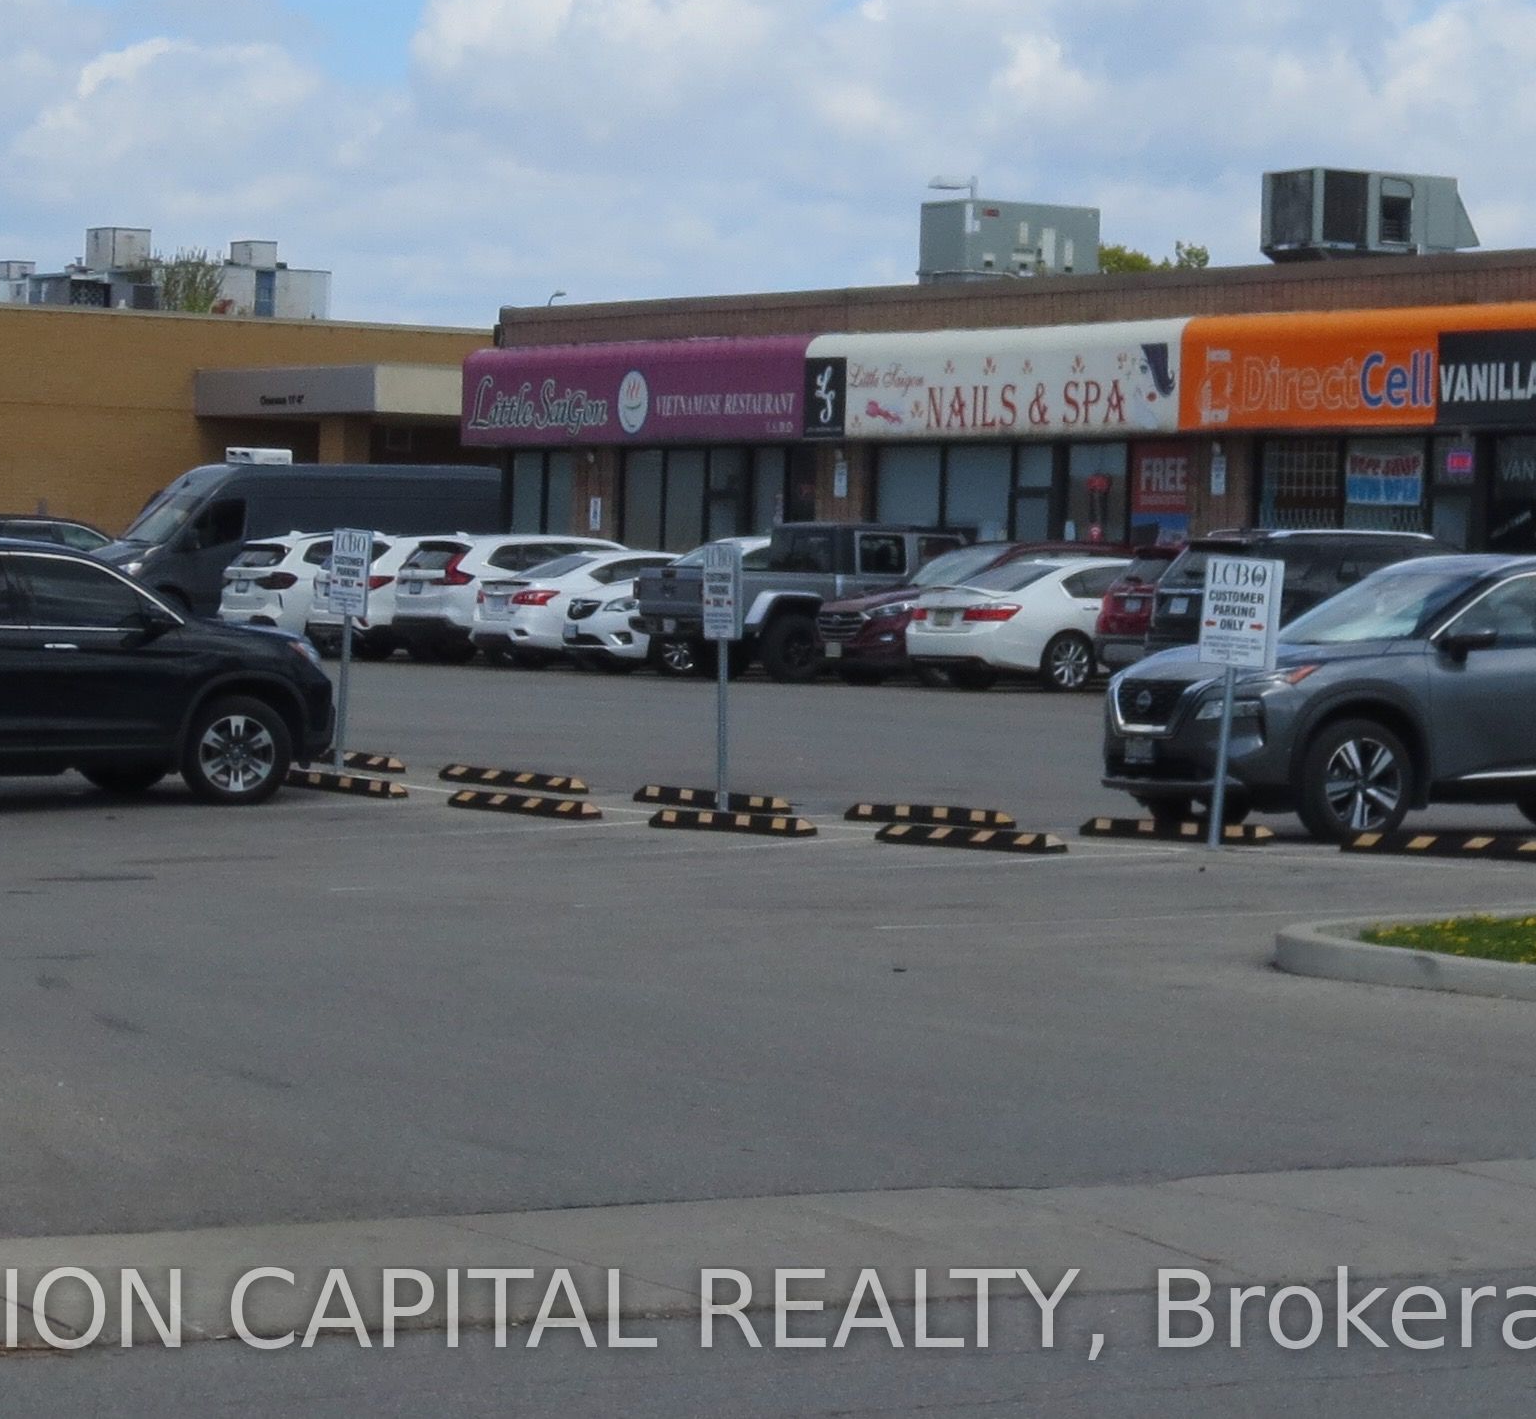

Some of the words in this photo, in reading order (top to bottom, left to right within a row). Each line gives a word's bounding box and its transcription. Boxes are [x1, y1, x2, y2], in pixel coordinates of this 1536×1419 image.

[1241, 349, 1434, 411] DirectCell
[467, 375, 534, 430] Little
[723, 391, 796, 416] RESTAURANT
[925, 382, 1017, 429] NAILS
[1028, 381, 1051, 425] &
[1062, 378, 1127, 425] SPA
[1140, 456, 1187, 492] FREE
[1210, 561, 1268, 588] LCBO
[1208, 589, 1265, 605] CUSTOMER
[1213, 604, 1257, 619] PARKING
[1219, 618, 1246, 631] ONLY
